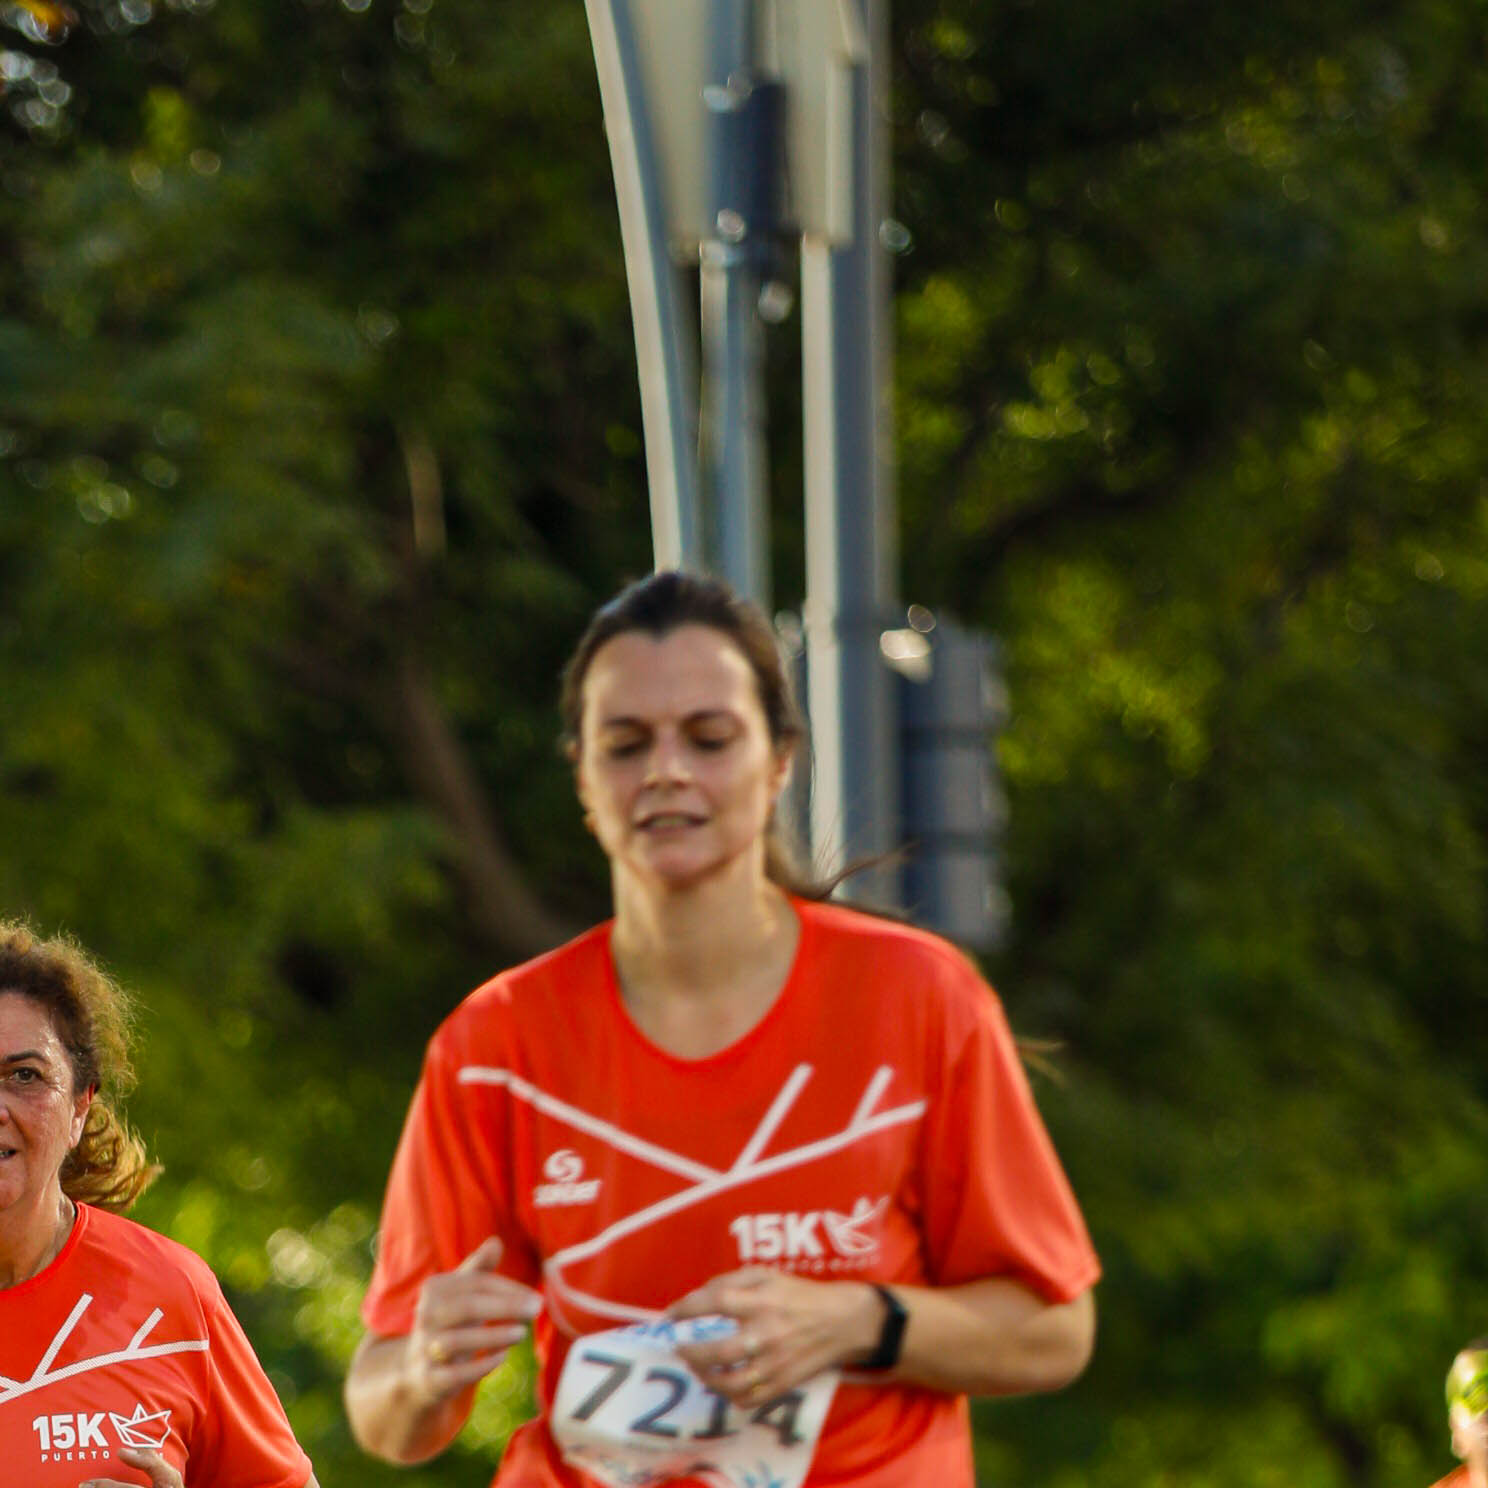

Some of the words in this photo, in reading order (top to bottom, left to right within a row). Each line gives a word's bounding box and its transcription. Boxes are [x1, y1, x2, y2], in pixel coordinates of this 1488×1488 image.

[729, 1211, 824, 1261] 15K
[571, 1348, 806, 1446] 7214
[33, 1412, 109, 1450] 15K
[41, 1450, 110, 1462] PUERTO
